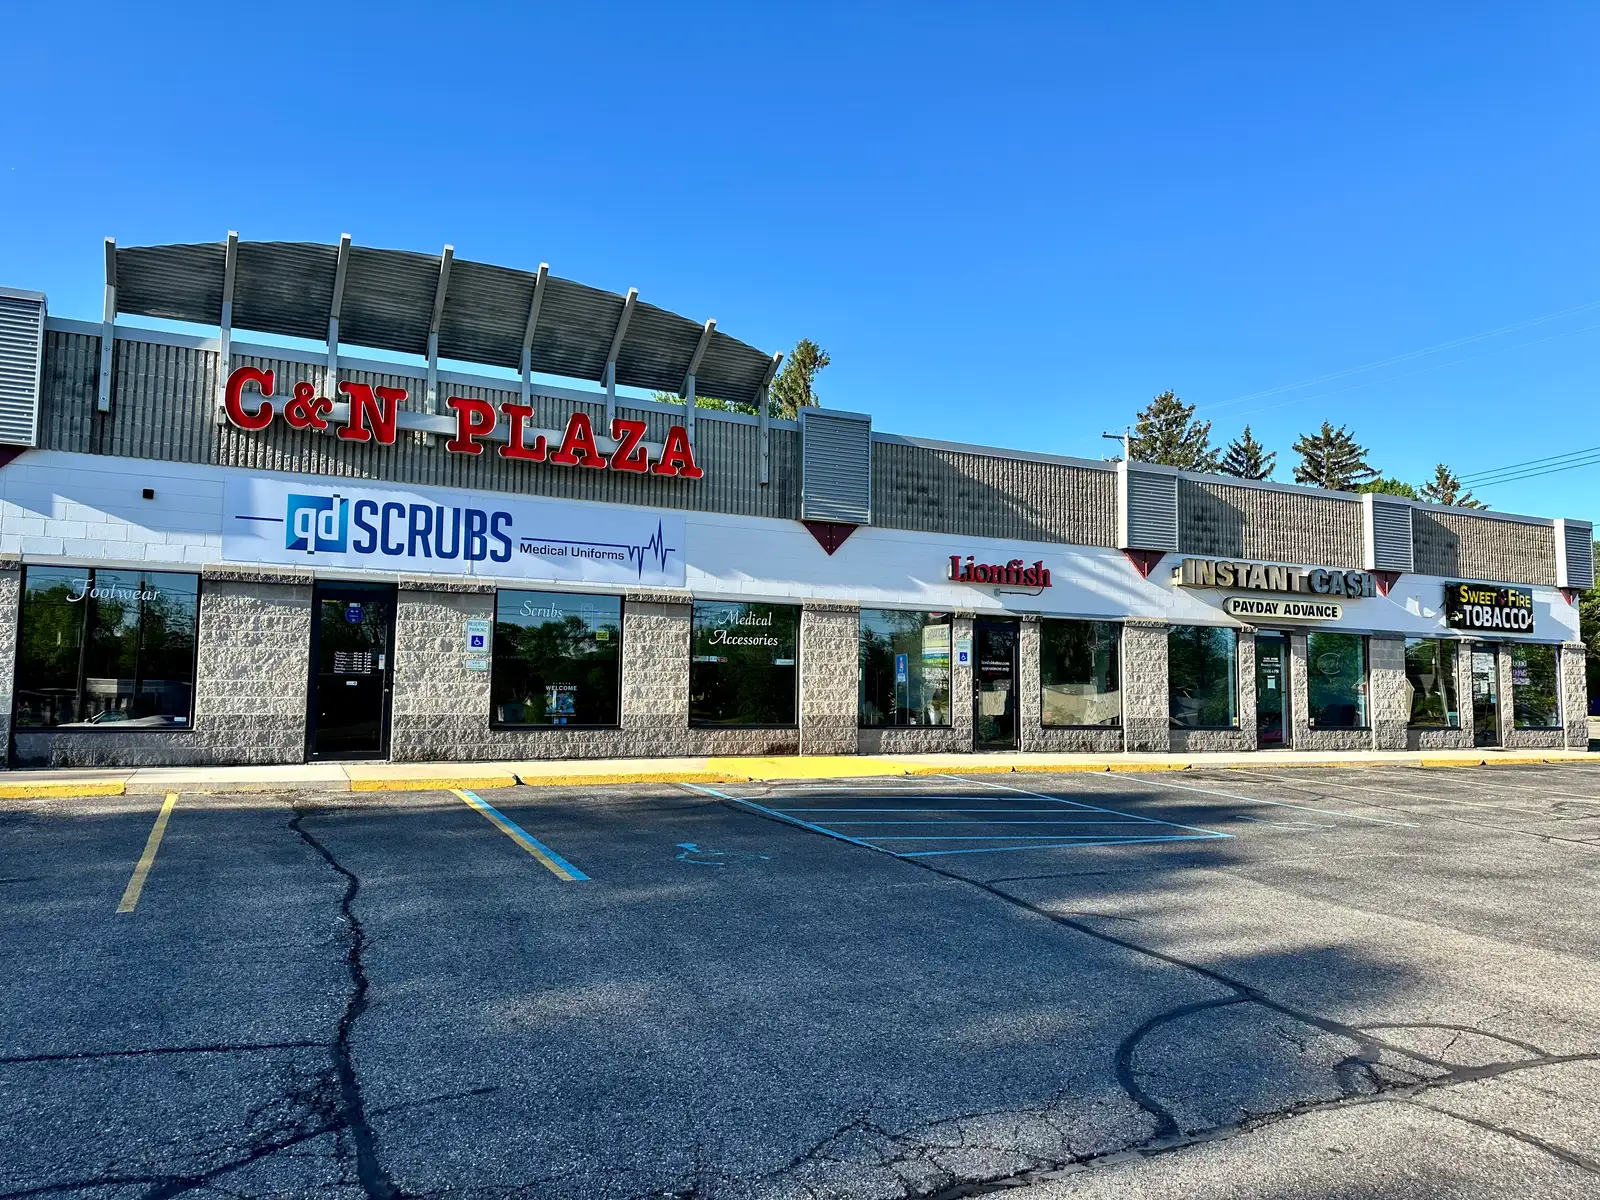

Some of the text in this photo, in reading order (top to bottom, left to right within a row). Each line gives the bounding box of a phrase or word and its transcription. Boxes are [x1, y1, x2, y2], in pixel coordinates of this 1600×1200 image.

[224, 366, 704, 478] C&N PLAZA
[353, 499, 513, 563] SCRUBS
[520, 543, 625, 560] Medical Uniforms
[948, 556, 1052, 587] Lionfish
[1182, 558, 1303, 592] INSTANT
[66, 579, 160, 602] Footwear
[520, 600, 563, 618] Scrubs
[717, 609, 772, 626] Medical
[1233, 600, 1338, 618] PAYDAY ADVANCE
[1463, 604, 1528, 629] TOBACCO
[708, 629, 778, 646] Accessories
